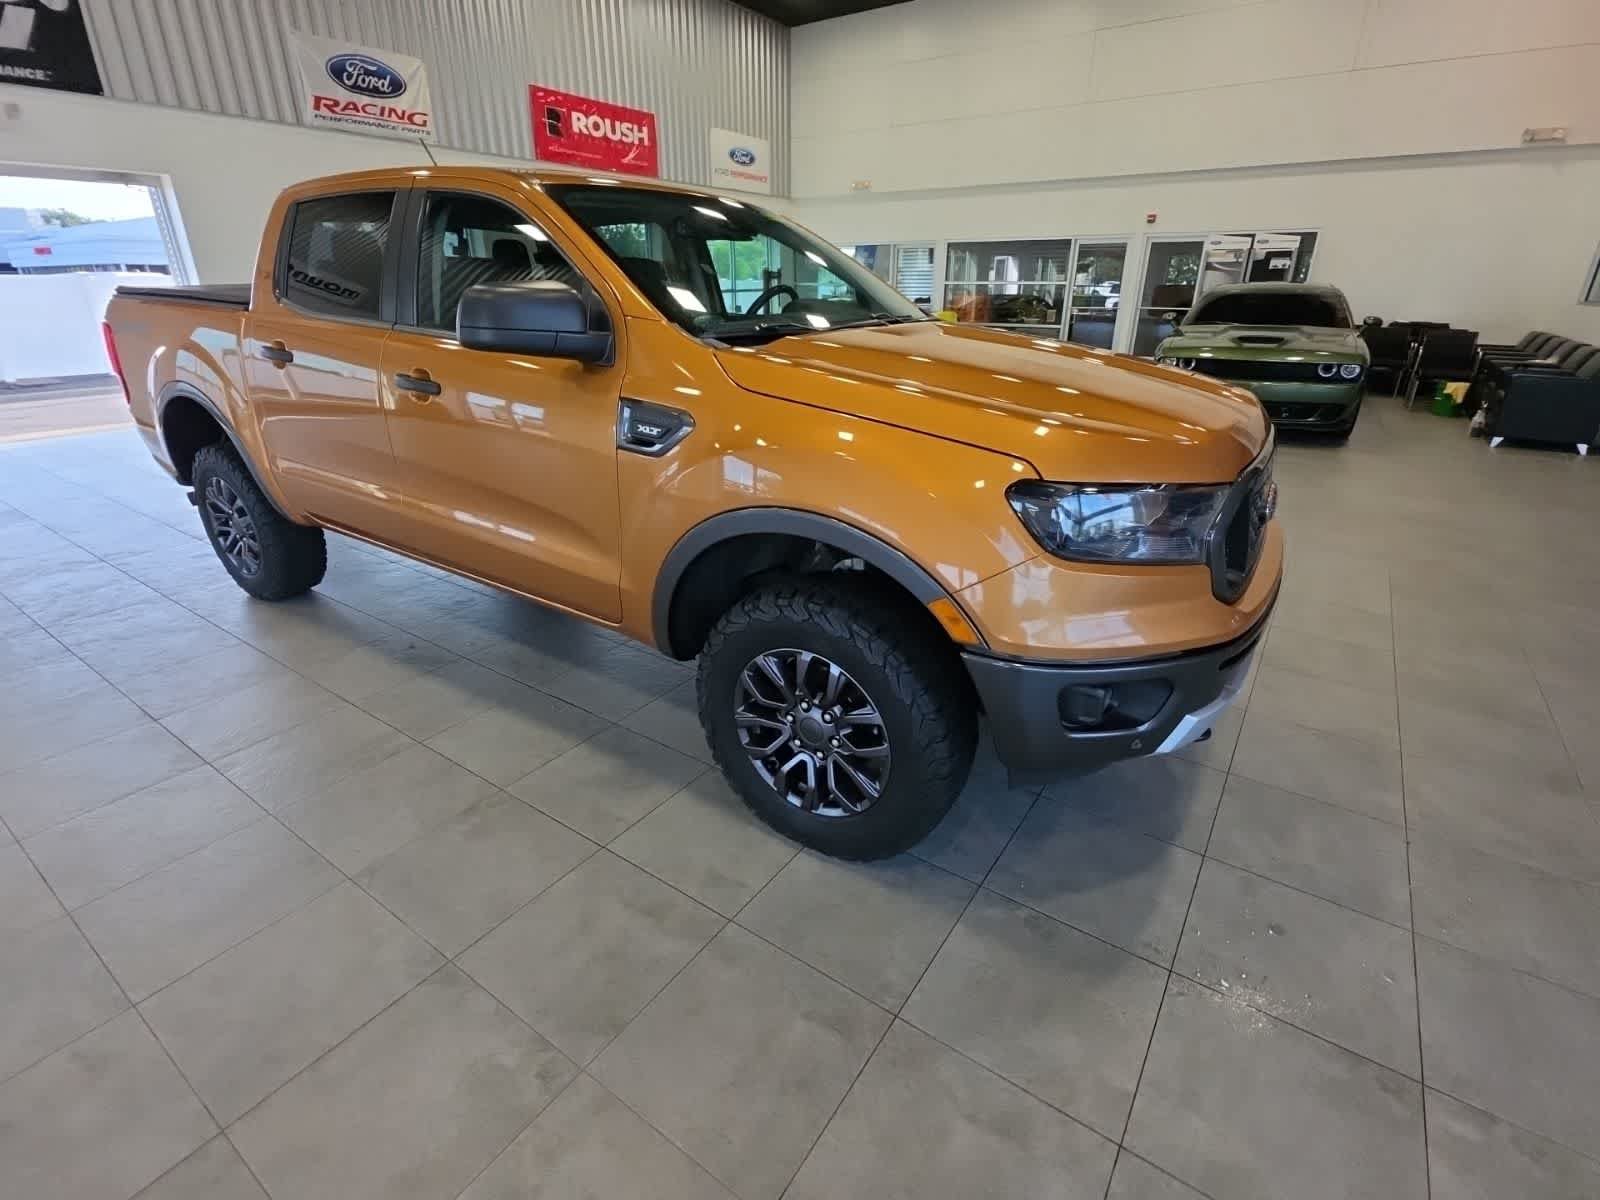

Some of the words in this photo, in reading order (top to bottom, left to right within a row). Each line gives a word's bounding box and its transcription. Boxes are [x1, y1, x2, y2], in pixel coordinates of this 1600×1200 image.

[343, 59, 392, 93] Ford
[312, 95, 428, 127] RACING
[314, 114, 399, 130] PERFORMANCE
[571, 111, 649, 146] ROUSH
